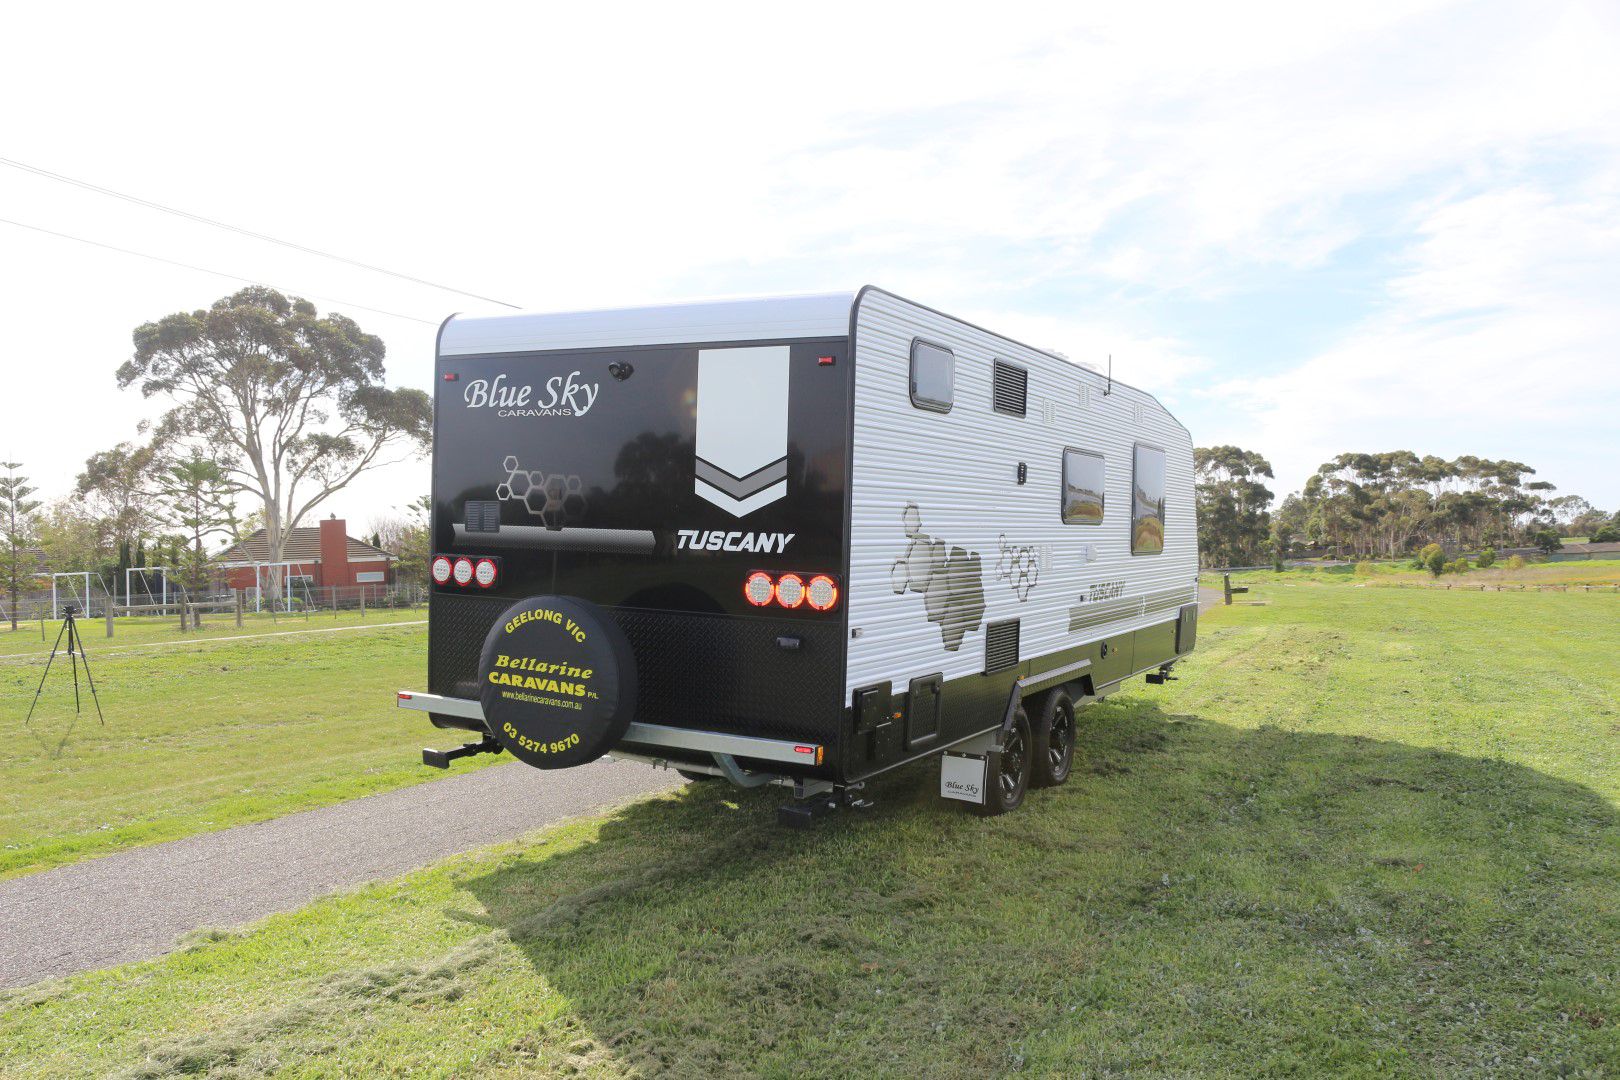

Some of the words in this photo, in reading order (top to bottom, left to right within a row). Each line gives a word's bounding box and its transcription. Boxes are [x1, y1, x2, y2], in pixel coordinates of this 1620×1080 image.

[464, 374, 532, 408] Blue
[538, 371, 599, 417] Sky
[498, 408, 572, 417] CARAVANS
[677, 529, 796, 554] TUSCANY
[505, 609, 563, 634] GEELONG
[565, 619, 586, 643] VIC
[495, 655, 593, 679] Bellarine
[488, 671, 586, 697] CARAVANS
[502, 690, 583, 711] www.bellarinecaravans.com.au
[503, 722, 518, 739] 03
[518, 735, 548, 754] 5274
[550, 733, 580, 754] 9670
[945, 781, 964, 789] Blue
[964, 784, 979, 794] Sky
